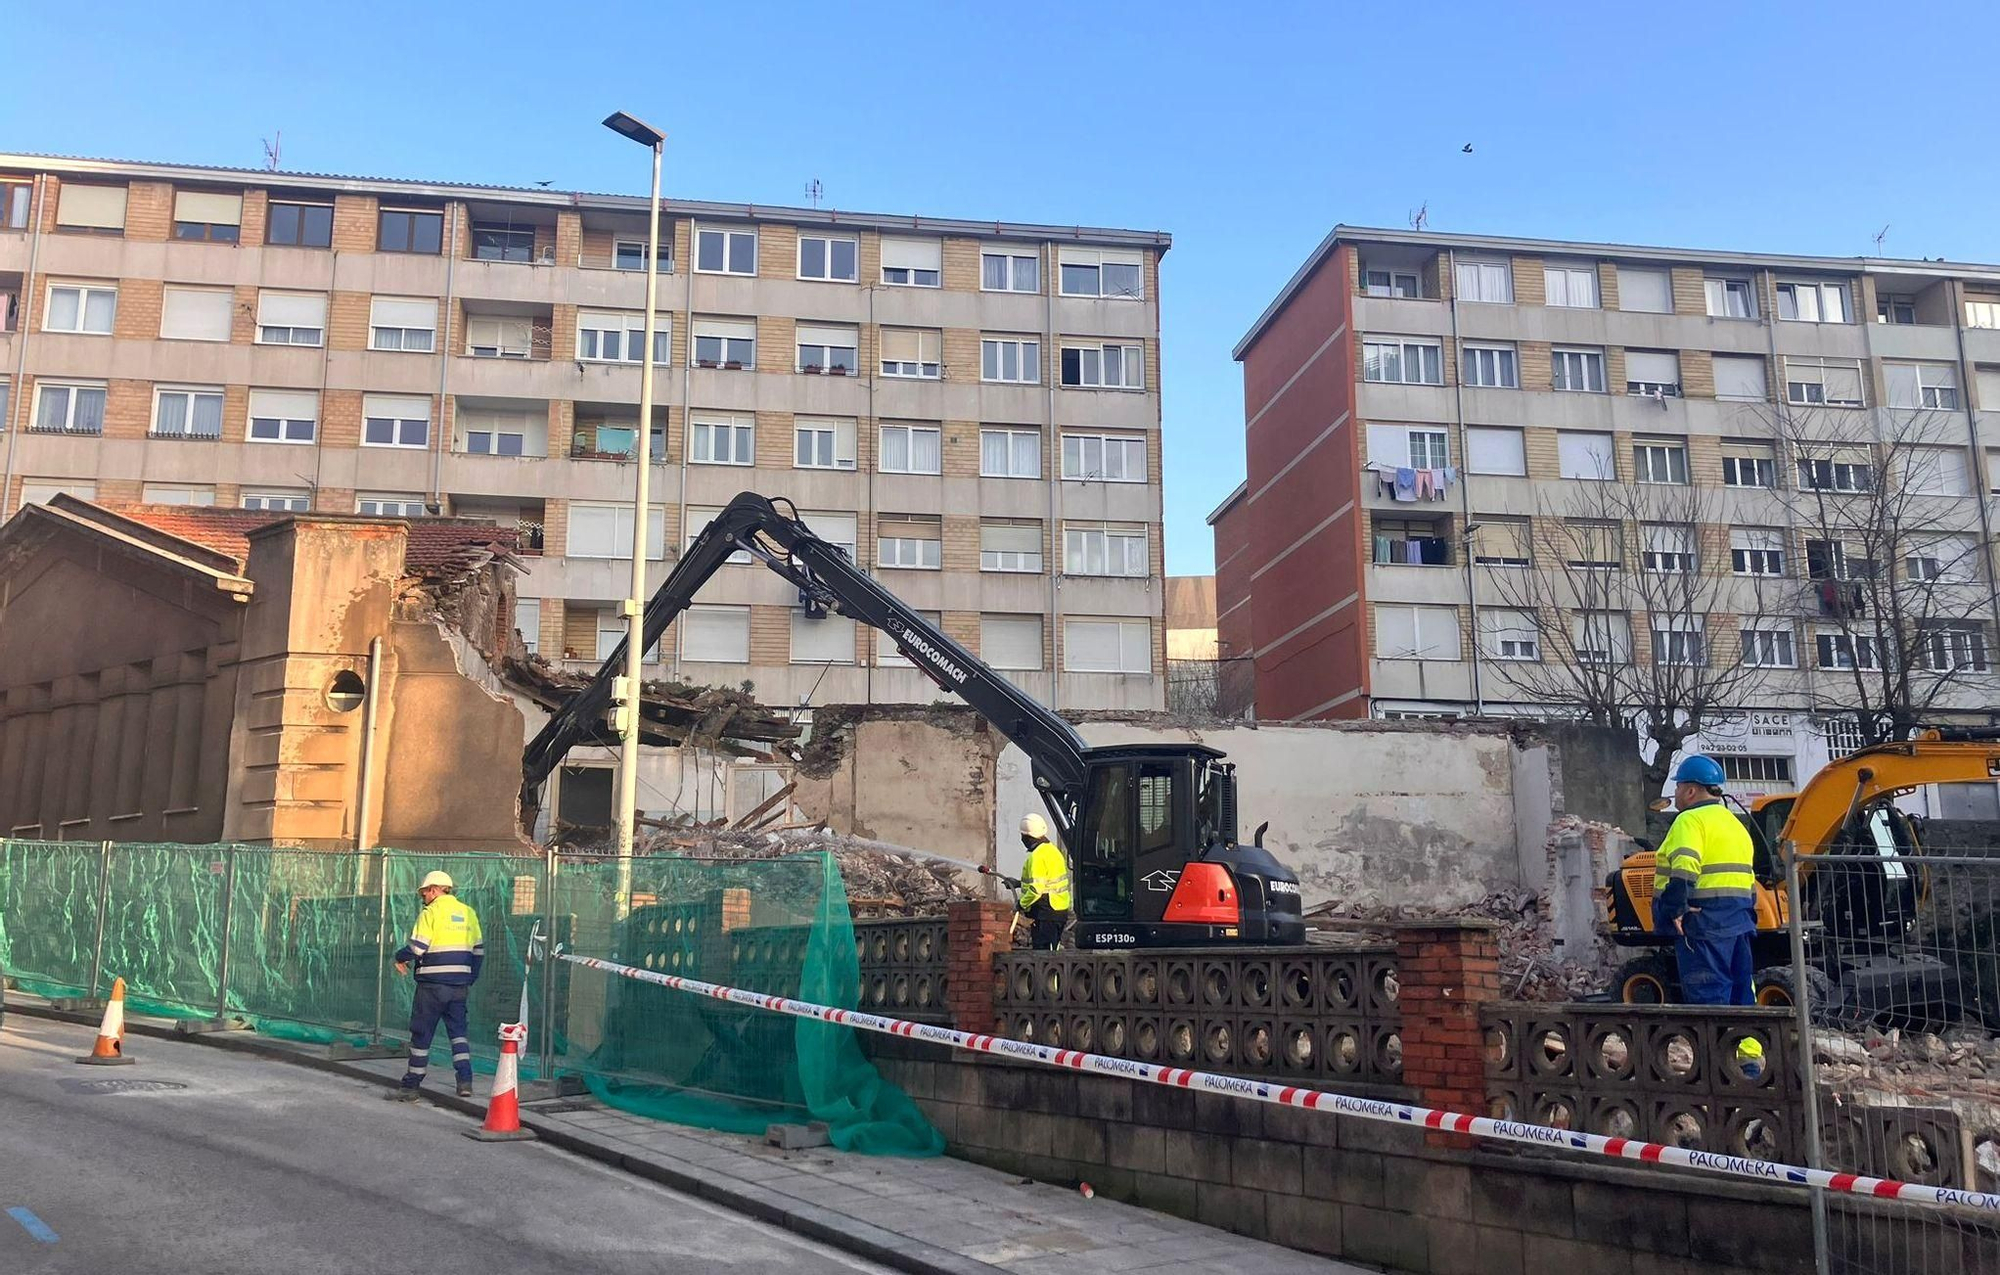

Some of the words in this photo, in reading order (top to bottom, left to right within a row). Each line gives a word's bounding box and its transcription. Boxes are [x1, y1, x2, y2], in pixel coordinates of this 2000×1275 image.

[902, 628, 968, 684] EUROCOMACH
[1754, 714, 1788, 725] SACE
[1000, 1040, 1036, 1056] PALOMERA
[1094, 1058, 1136, 1073] PALOMERA
[1204, 1075, 1253, 1094] PALOMERA
[1335, 1096, 1394, 1118] PALOMERA
[1493, 1120, 1565, 1144] PALOMERA
[1688, 1151, 1779, 1178] PALOMERA
